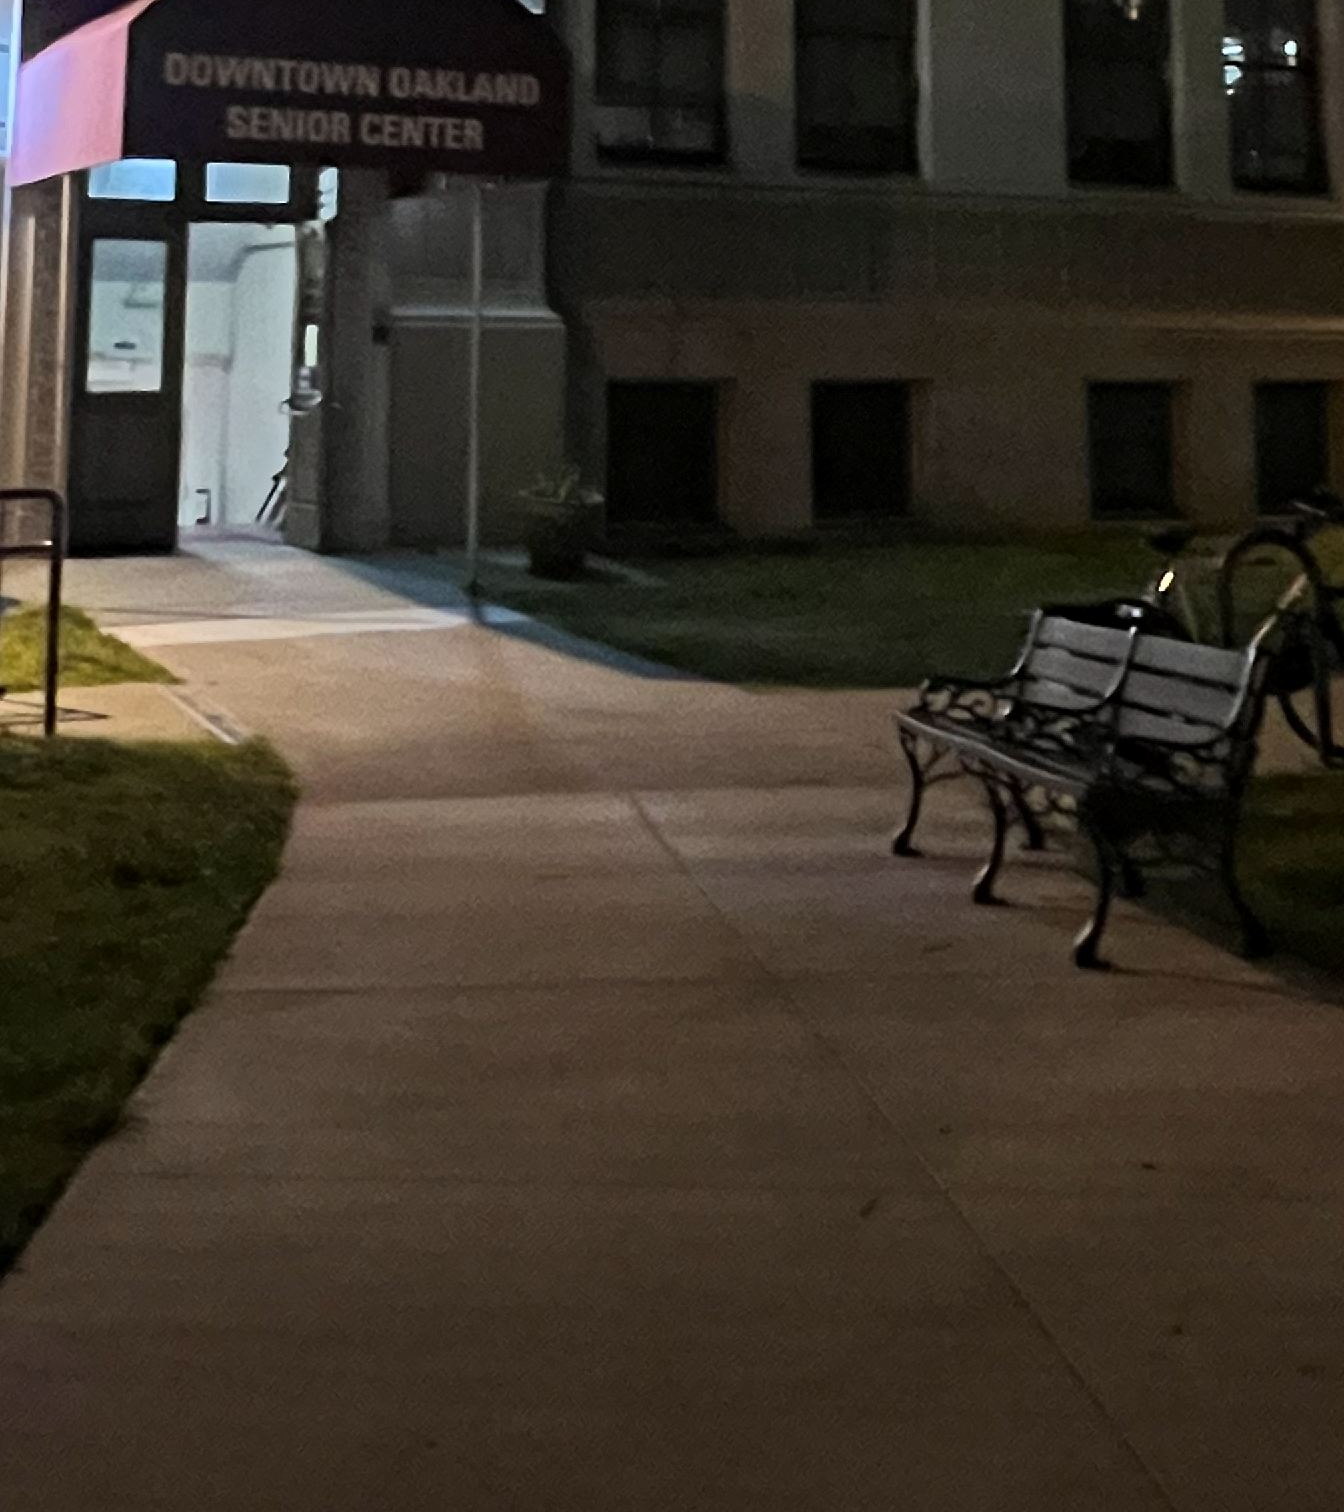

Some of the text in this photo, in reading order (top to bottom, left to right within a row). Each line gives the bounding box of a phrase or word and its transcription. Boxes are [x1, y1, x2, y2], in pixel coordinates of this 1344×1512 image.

[164, 53, 541, 105] DOWNTOWN OAKLAND
[227, 106, 484, 150] SENIOR CENTER
